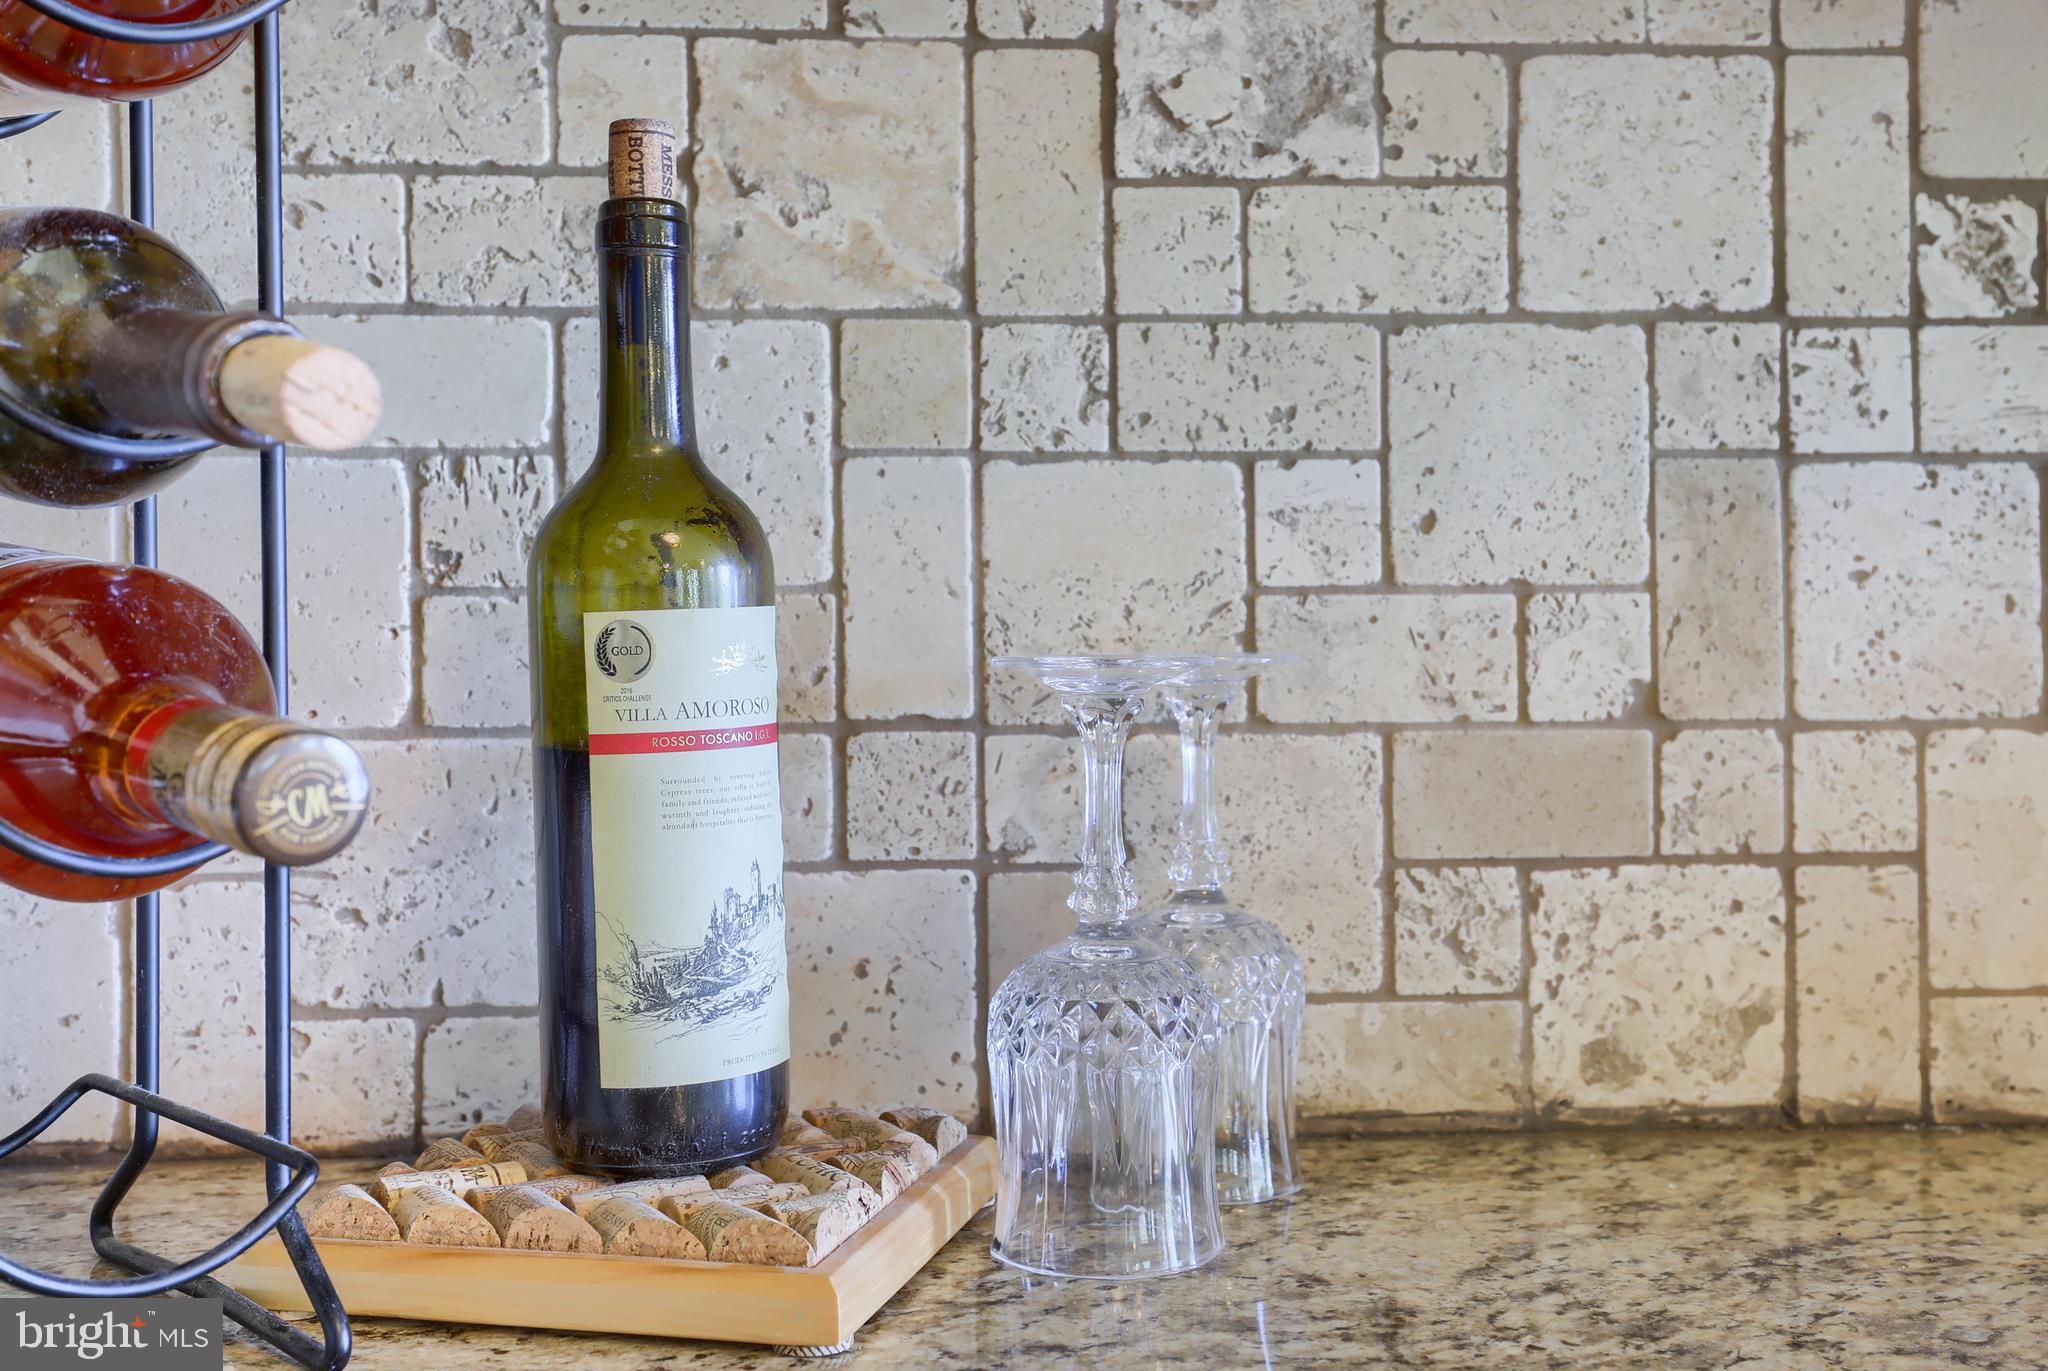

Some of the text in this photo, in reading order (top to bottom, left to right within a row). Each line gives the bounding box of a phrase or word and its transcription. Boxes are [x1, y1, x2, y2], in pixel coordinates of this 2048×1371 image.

[611, 646, 644, 657] GOLD
[622, 694, 652, 702] CHALLENGE
[615, 695, 770, 722] VILLA AMOROSO
[652, 735, 696, 748] ROSSO
[700, 731, 753, 745] TOSCANO
[660, 776, 706, 785] Surrounded
[660, 789, 692, 798] Cypress
[661, 799, 686, 808] family
[688, 798, 702, 806] and
[661, 810, 691, 819] warmth
[695, 808, 709, 817] and
[662, 820, 698, 830] abundant
